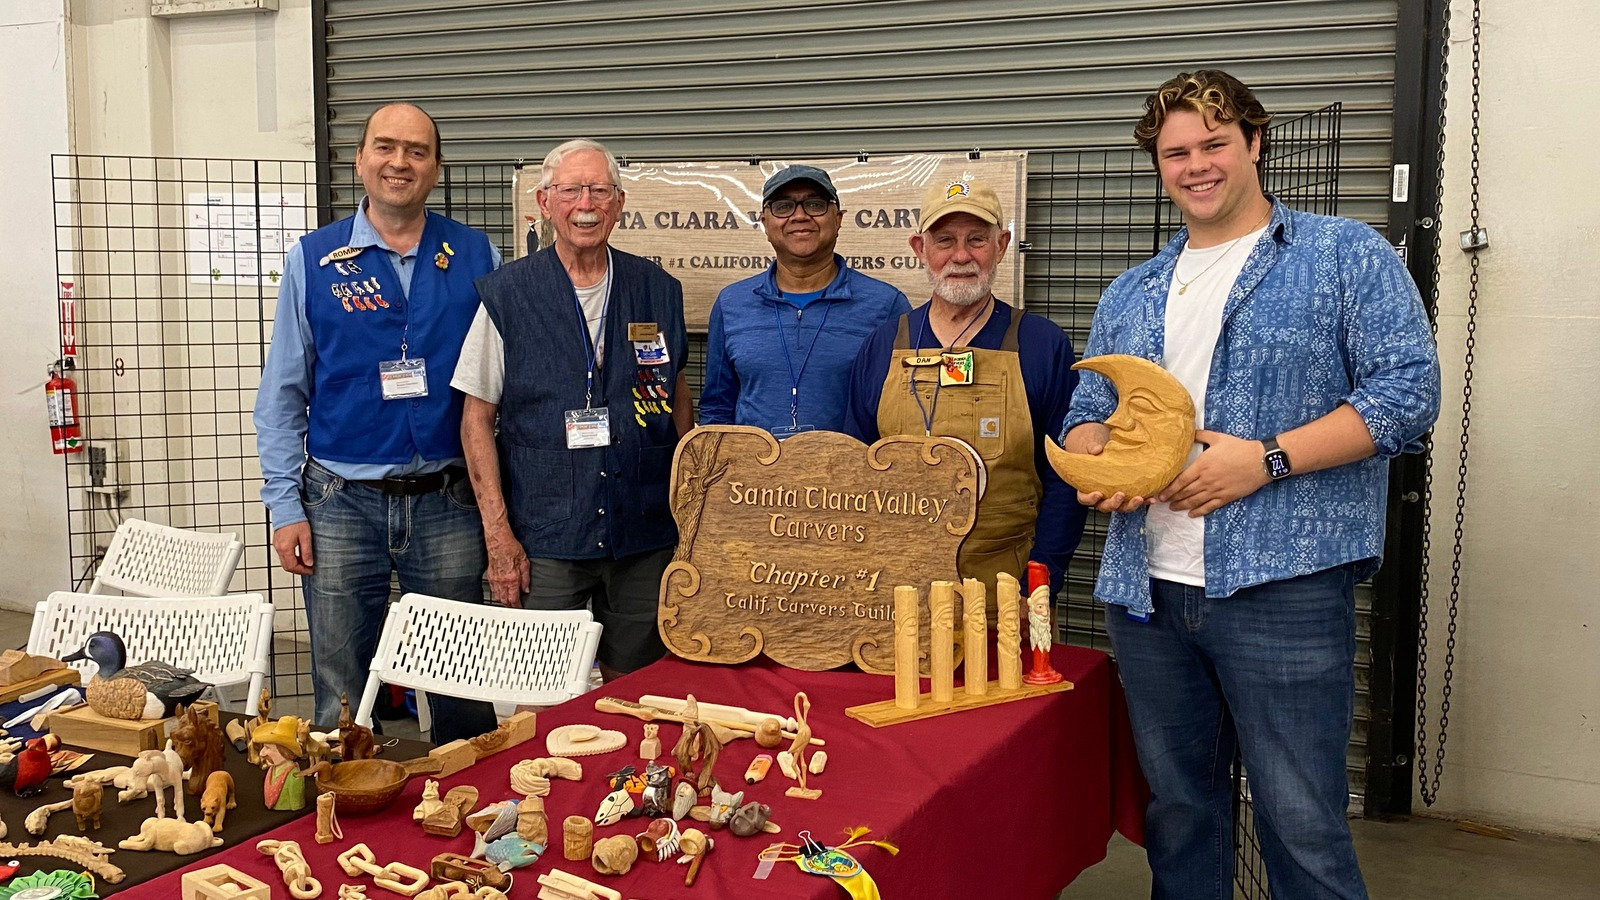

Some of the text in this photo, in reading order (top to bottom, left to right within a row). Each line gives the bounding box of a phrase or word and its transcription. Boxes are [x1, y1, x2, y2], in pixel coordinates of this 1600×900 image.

[654, 211, 739, 230] CLARA
[332, 247, 362, 259] ROMAN
[668, 256, 685, 269] #1
[727, 481, 949, 524] Santa Clara Valley
[768, 512, 866, 543] Carvers
[750, 560, 882, 594] Chapter #1
[724, 592, 771, 615] Calif.
[776, 596, 846, 617] Carvers
